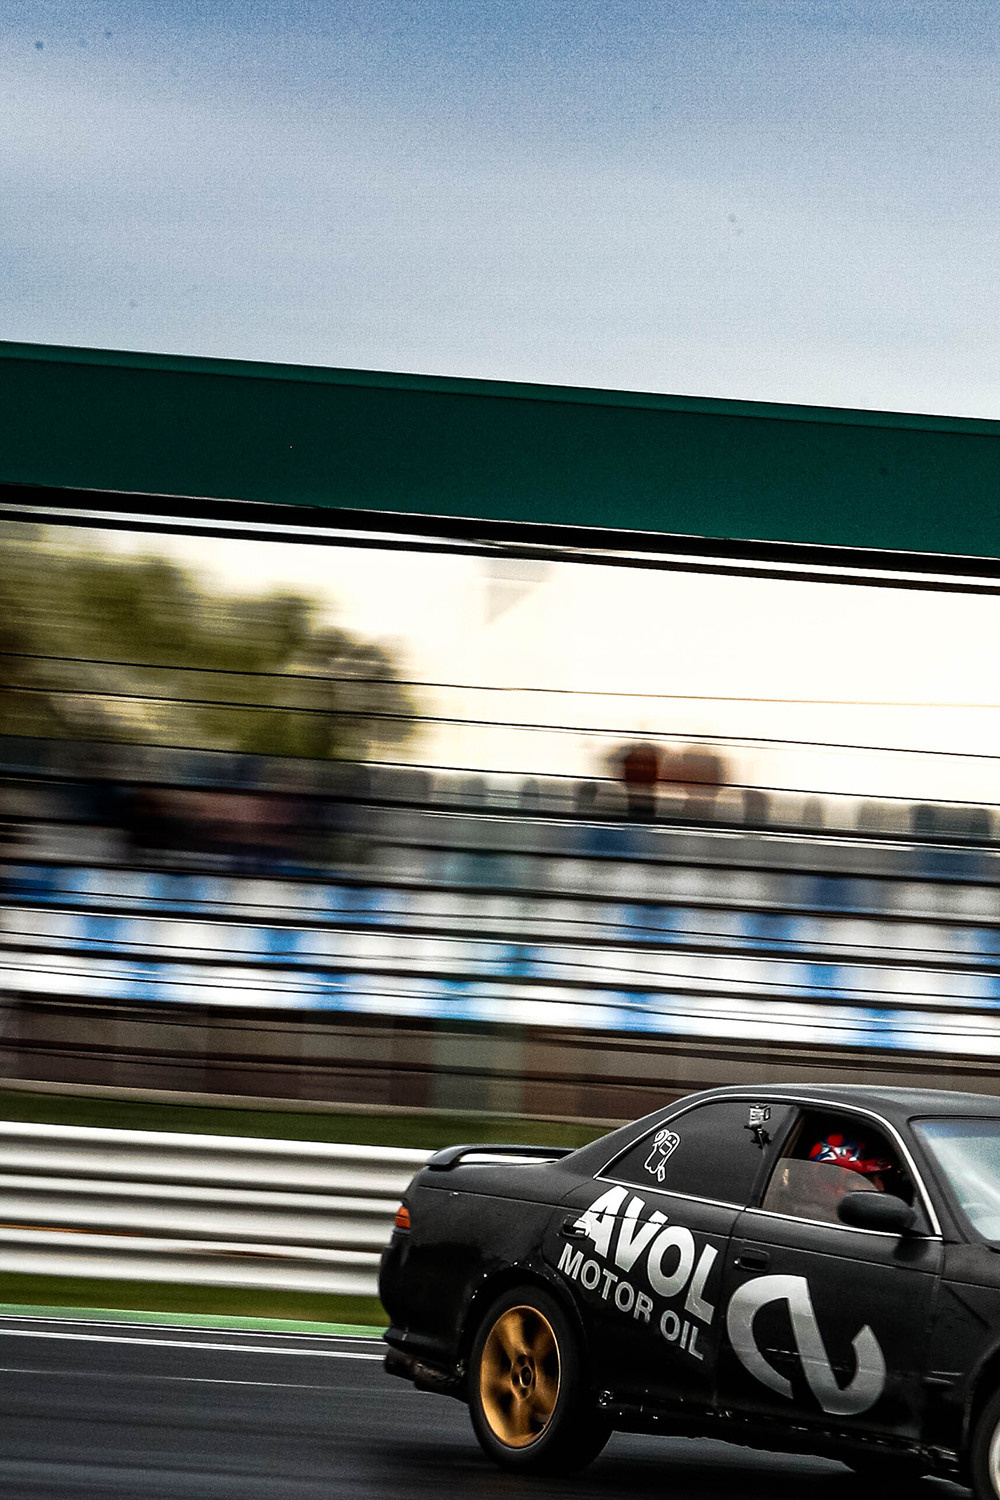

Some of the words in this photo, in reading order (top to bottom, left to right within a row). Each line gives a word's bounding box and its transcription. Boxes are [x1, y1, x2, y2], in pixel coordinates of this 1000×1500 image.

[557, 1242, 654, 1324] MOTOR
[659, 1309, 704, 1361] OIL
[573, 1185, 719, 1325] AVOL
